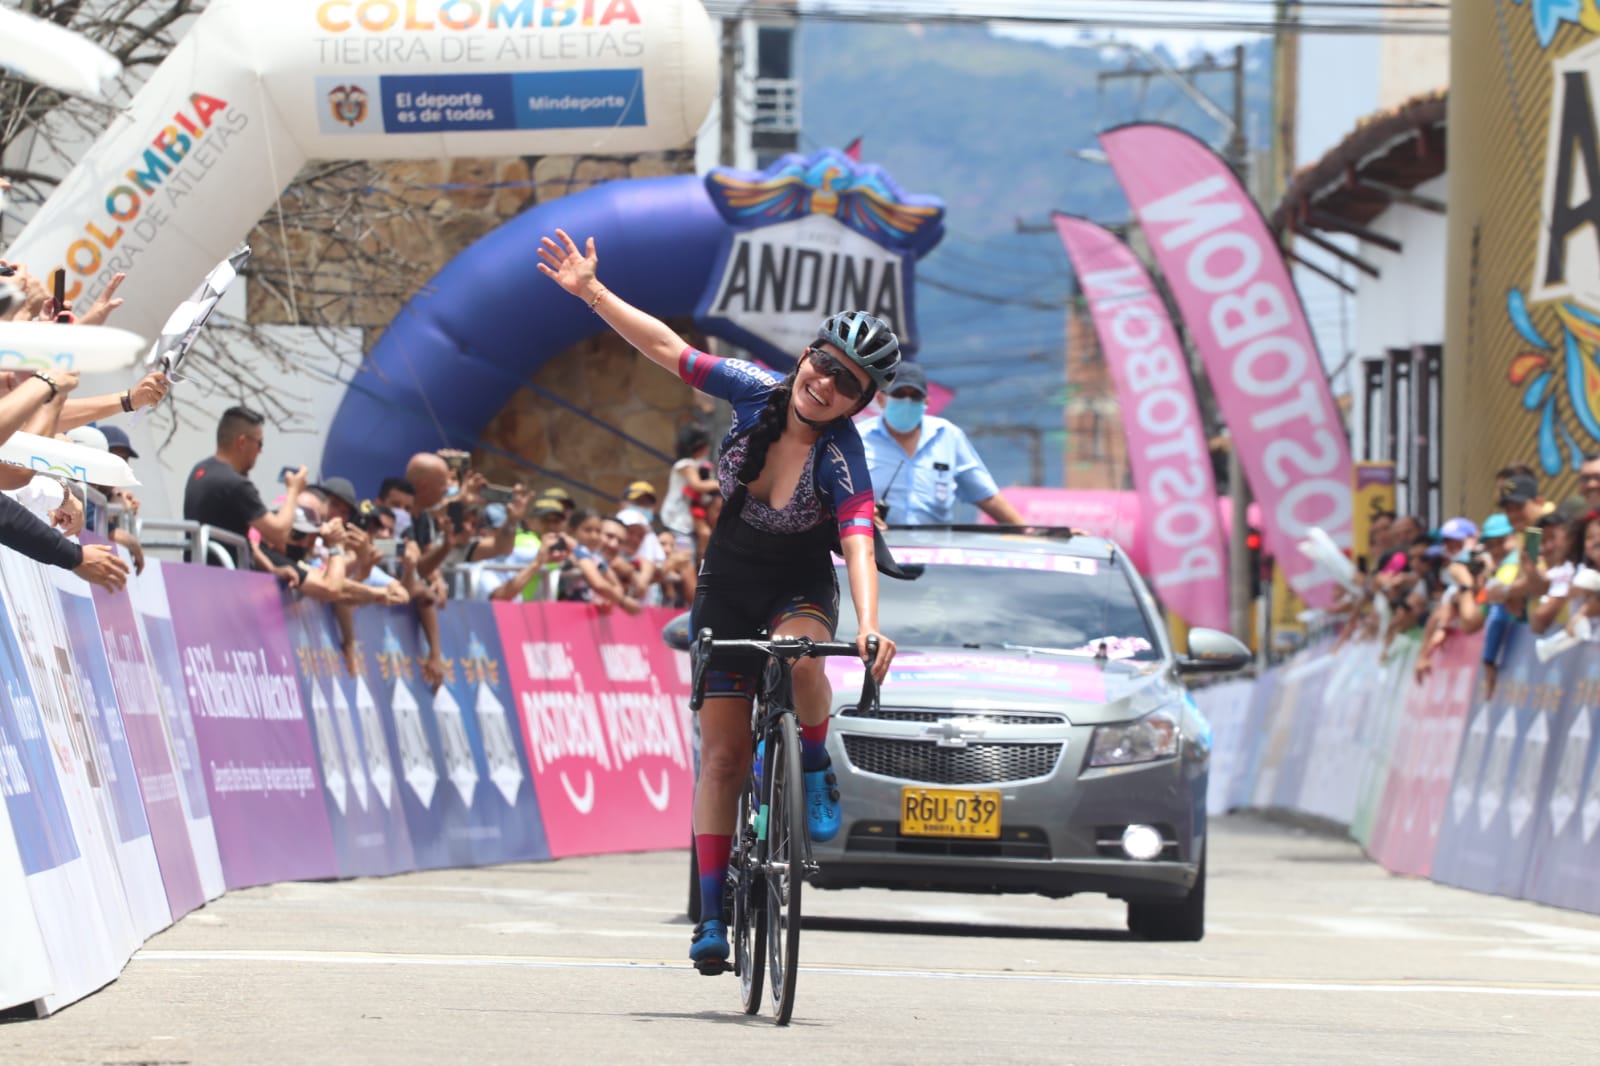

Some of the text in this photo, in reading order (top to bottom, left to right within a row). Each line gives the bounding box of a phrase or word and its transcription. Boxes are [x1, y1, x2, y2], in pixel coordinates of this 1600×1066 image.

[316, 0, 642, 32] COLOMBIA
[315, 31, 645, 64] TIERRA DE ATLETAS
[396, 91, 482, 111] El deporte
[398, 106, 495, 122] es de todos
[529, 94, 625, 111] Mindeporte
[134, 202, 169, 244] DE
[165, 106, 249, 209] ATLETAS
[47, 91, 228, 302] COLOMBIA
[718, 239, 903, 337] ANDINA
